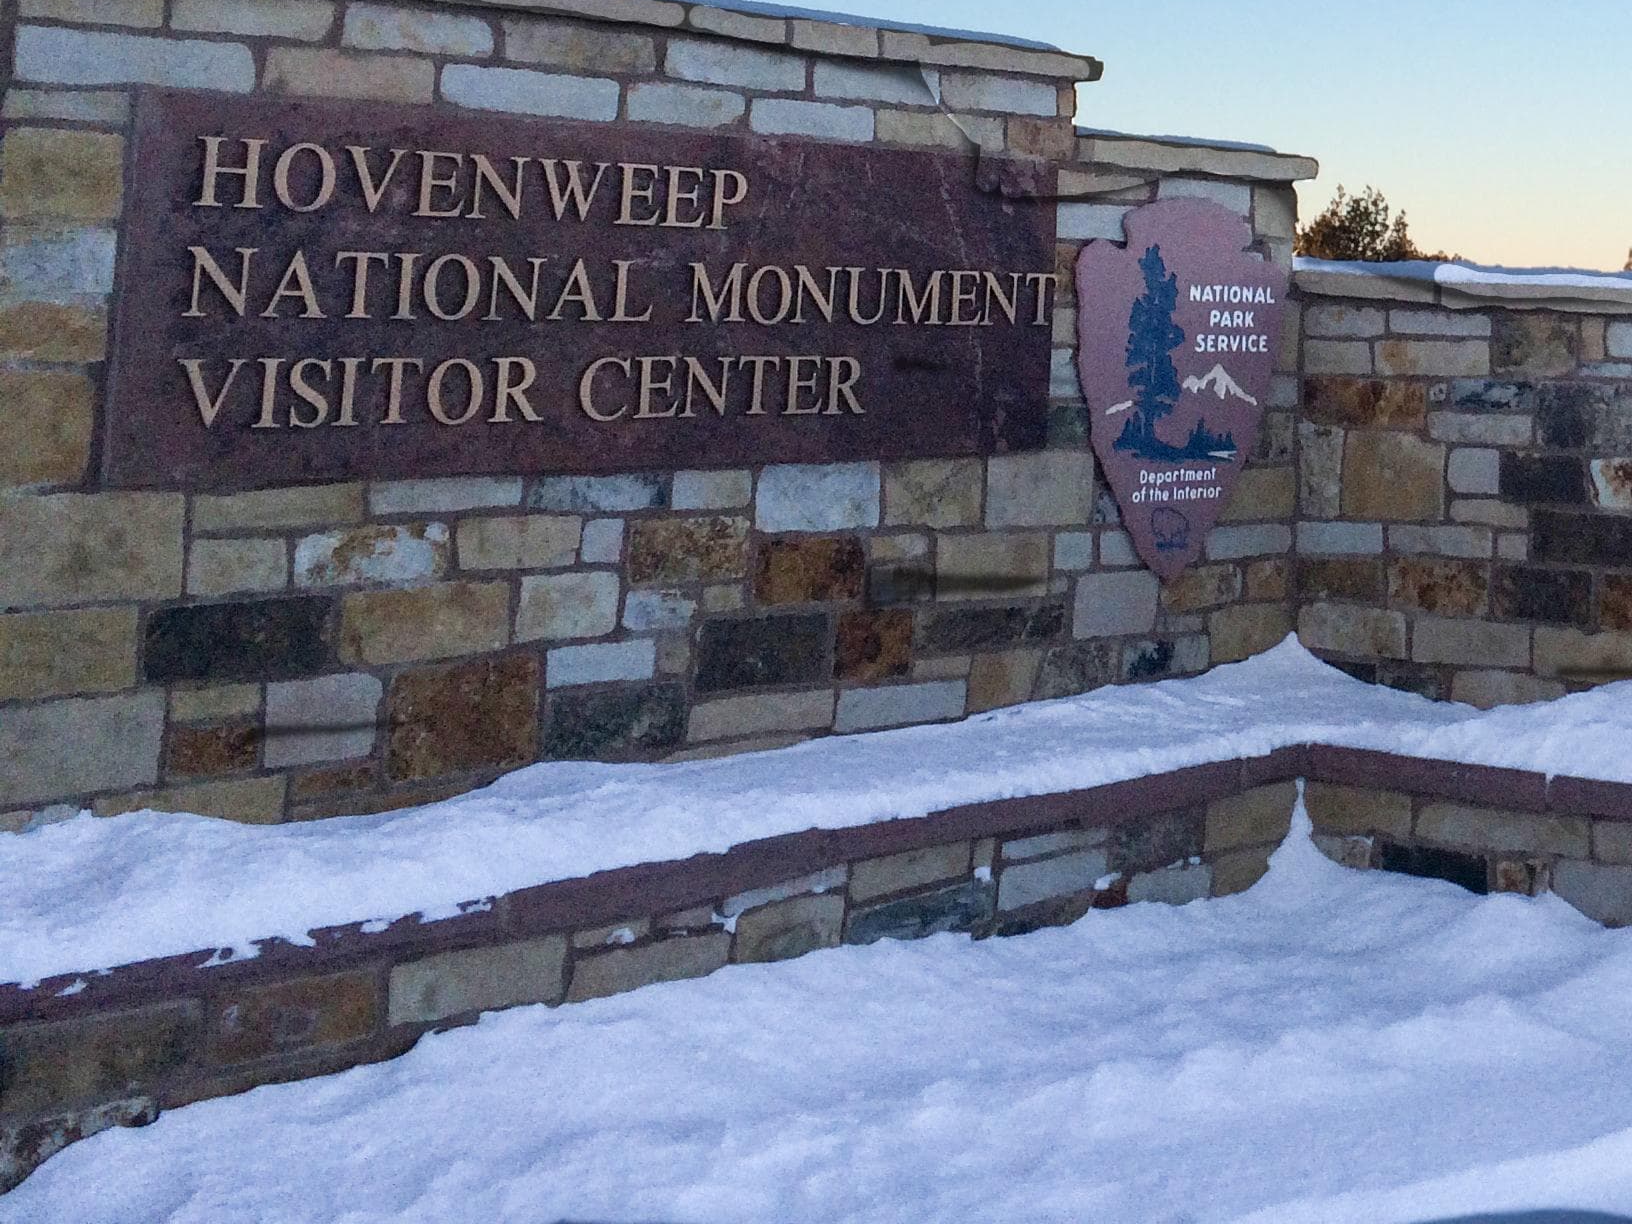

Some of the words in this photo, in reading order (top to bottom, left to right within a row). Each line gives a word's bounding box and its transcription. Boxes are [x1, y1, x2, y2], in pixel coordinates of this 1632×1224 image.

[192, 136, 748, 229] HOVENWEEP
[181, 246, 653, 322] NATIONAL
[685, 262, 1057, 327] MONUMENT
[1190, 285, 1275, 304] NATIONAL
[1210, 310, 1254, 328] PARK
[1195, 334, 1268, 353] SERVICE
[177, 356, 544, 430] VISITOR
[578, 356, 867, 422] CENTER
[1140, 467, 1216, 486] Department
[1132, 487, 1147, 503] of
[1149, 486, 1169, 501] the
[1173, 485, 1222, 500] Interior
